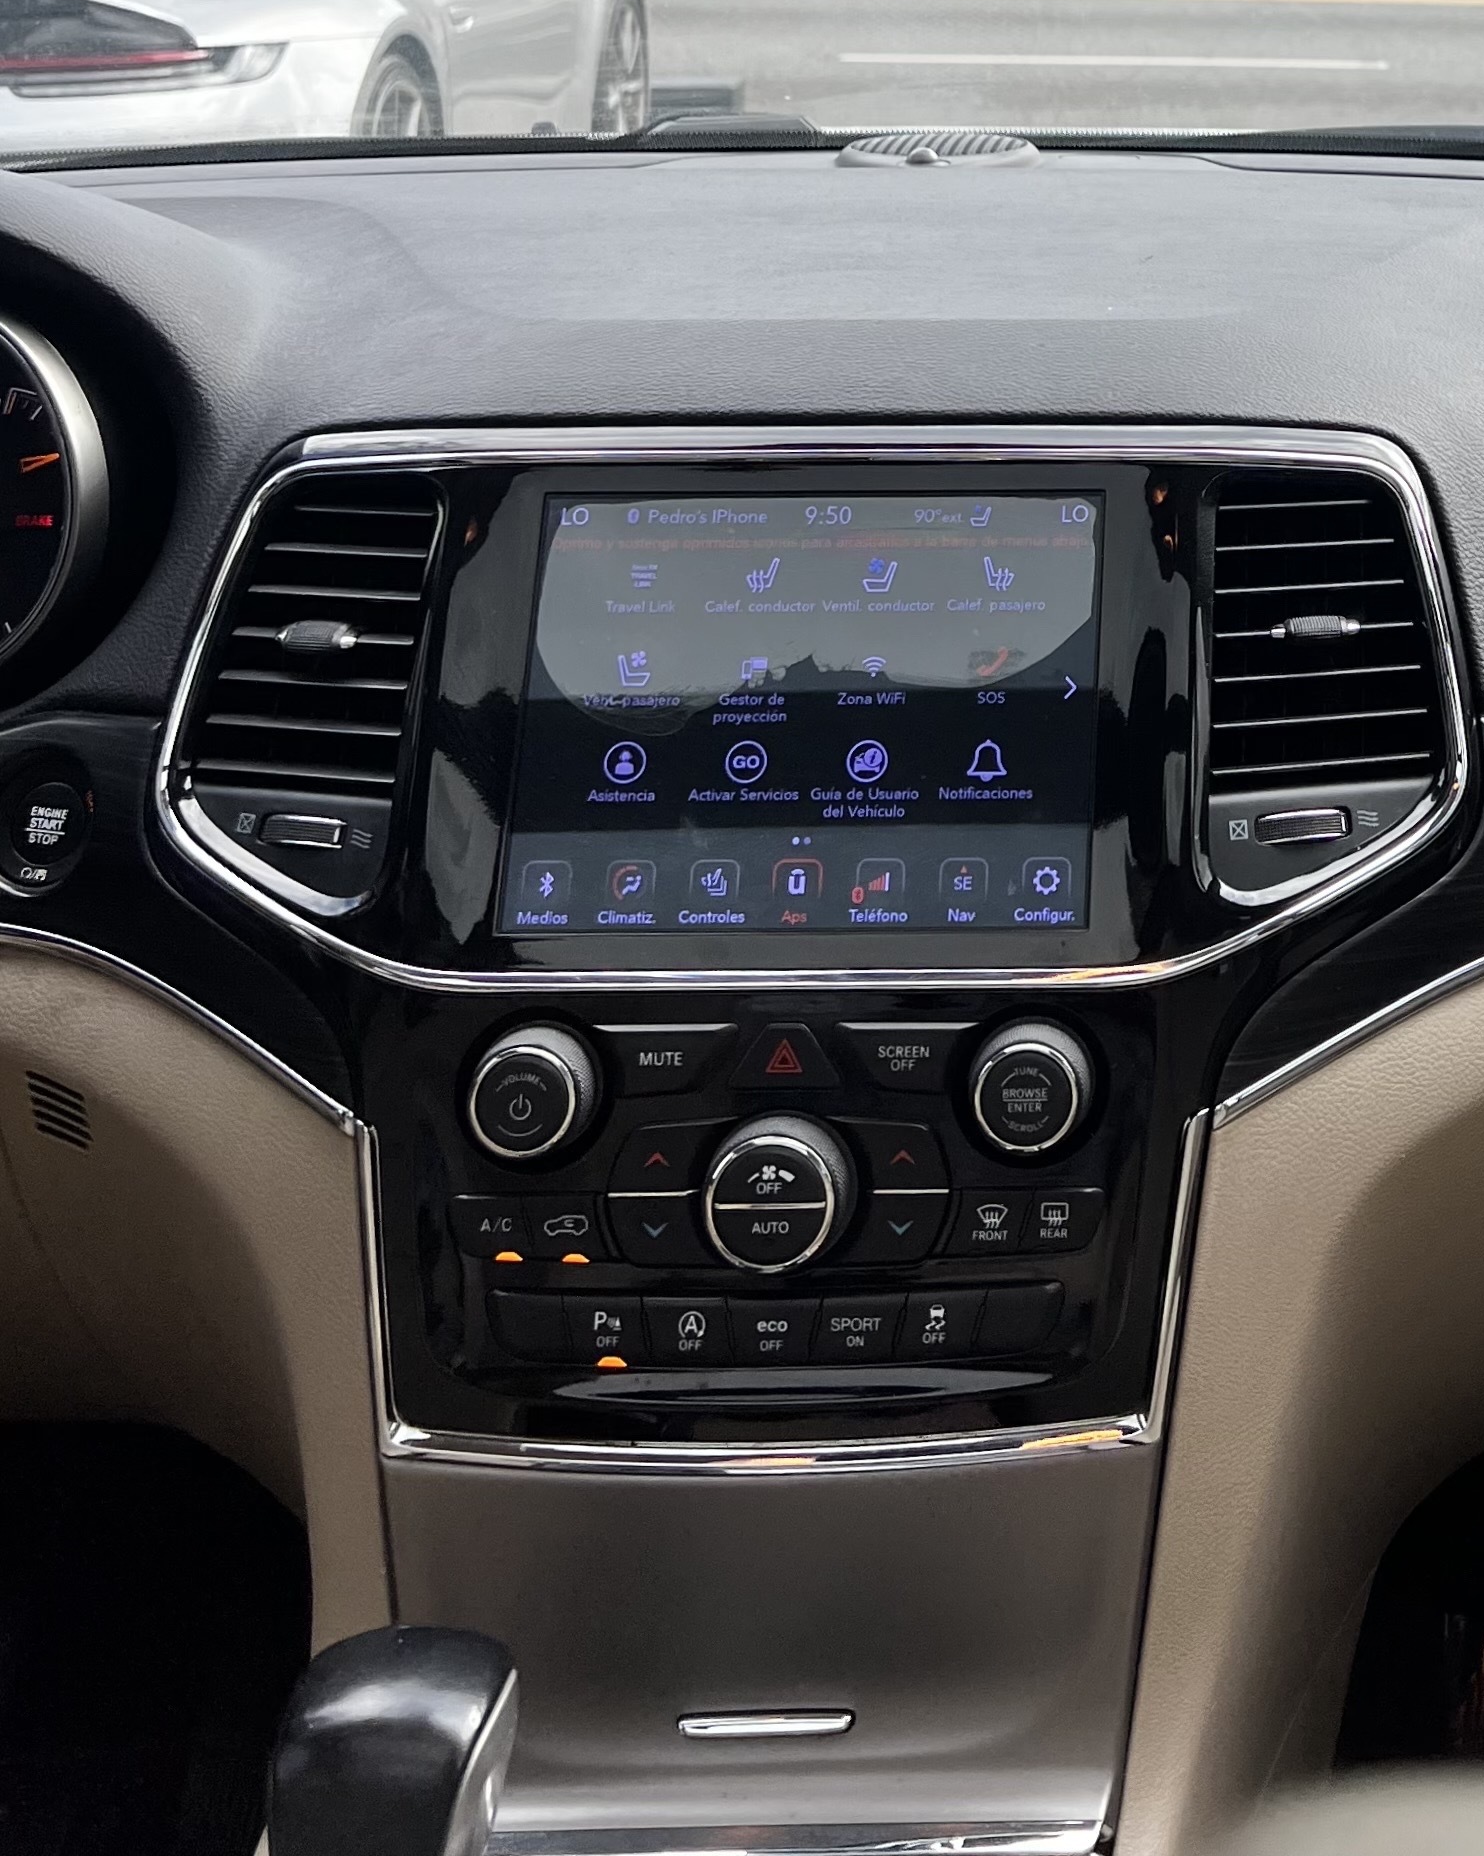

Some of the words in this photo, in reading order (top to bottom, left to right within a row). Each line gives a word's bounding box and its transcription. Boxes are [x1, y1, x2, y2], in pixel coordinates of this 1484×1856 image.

[15, 515, 54, 527] BRAKE
[560, 507, 589, 526] LO
[805, 506, 852, 526] 9:50
[1061, 506, 1090, 524] LO
[606, 599, 644, 614] Travel
[648, 599, 676, 614] Link
[705, 599, 742, 614] Calef.
[748, 599, 815, 613] conductor
[822, 599, 862, 613] Ventil.
[867, 599, 935, 613] conductor
[989, 598, 1045, 614] pasajero
[622, 693, 680, 709] pasajero
[719, 693, 766, 707] Gestor
[769, 692, 785, 706] de
[837, 692, 872, 705] Zona
[977, 692, 1005, 705] SOS
[713, 707, 787, 724] proyección
[732, 755, 761, 769] GO
[587, 788, 655, 802] Asistencia
[688, 788, 736, 802] Activar
[740, 788, 799, 802] Servicios
[810, 786, 843, 802] Guía
[847, 787, 863, 801] de
[868, 787, 919, 801] Usuario
[938, 786, 1033, 801] Notificaciones
[30, 806, 69, 820] ENGINE
[823, 804, 844, 818] del
[847, 804, 905, 818] Vehículo
[29, 818, 65, 830] START
[28, 833, 58, 845] STOP
[953, 875, 972, 890] SE
[517, 911, 568, 925] Medios
[597, 910, 656, 925] Climatiz.
[678, 910, 745, 925] Controles
[782, 910, 808, 926] Aps
[848, 909, 908, 924] Teléfono
[947, 910, 976, 923] Nav
[1014, 908, 1075, 925] Configur.
[639, 1050, 683, 1068] MUTE
[878, 1045, 930, 1059] SCREEN
[890, 1058, 916, 1072] OFF
[1014, 1066, 1039, 1077] TUNE
[502, 1073, 540, 1085] VOLUME
[1002, 1088, 1048, 1098] BROWSE
[1008, 1103, 1042, 1113] ENTER
[1008, 1121, 1043, 1132] SCROLL
[756, 1181, 782, 1195] OFF
[480, 1217, 513, 1234] A/C
[752, 1220, 789, 1236] AUTO
[972, 1229, 1009, 1242] FRONT
[1039, 1227, 1068, 1239] REAR
[757, 1317, 788, 1333] eco
[830, 1316, 881, 1333] SPORT
[596, 1336, 620, 1348] OFF
[846, 1335, 865, 1348] ON
[922, 1331, 946, 1344] OFF
[678, 1339, 703, 1351] OFF
[759, 1338, 784, 1352] OFF
